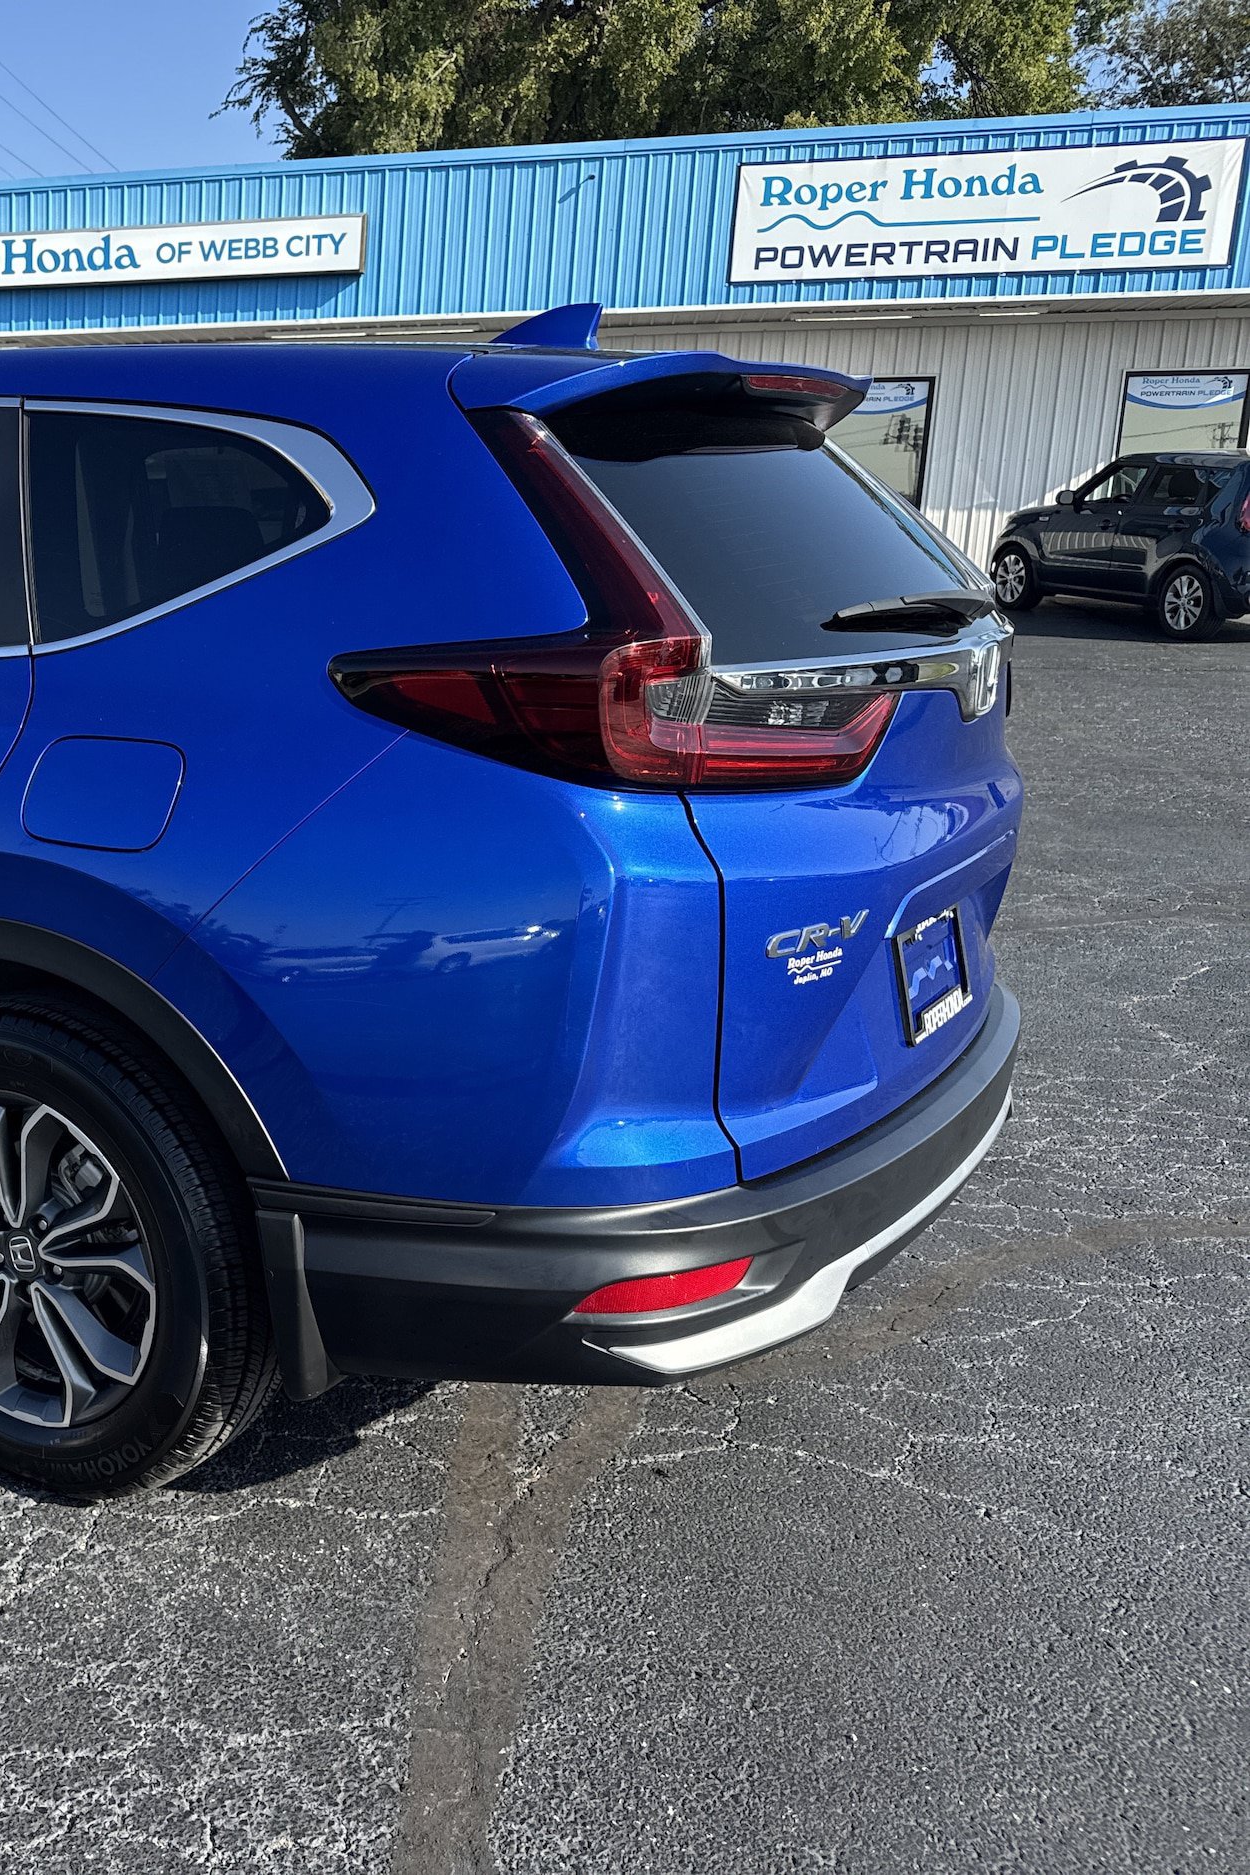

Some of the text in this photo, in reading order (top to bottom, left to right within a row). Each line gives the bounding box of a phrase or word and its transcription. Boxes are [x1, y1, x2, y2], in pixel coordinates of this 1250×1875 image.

[759, 163, 1044, 211] Roper Honda
[1, 234, 141, 276] Honda
[155, 241, 193, 264] OF
[199, 237, 280, 262] WEBB
[285, 232, 348, 257] CITY
[753, 228, 1207, 271] POWERTRAIN PLEDGE
[1140, 388, 1232, 397] POWERTRAIN PLEDGE
[1141, 376, 1201, 386] Roper Honda
[765, 909, 870, 958] CR-V
[787, 946, 843, 969] Roper Honda
[819, 966, 834, 978] MO
